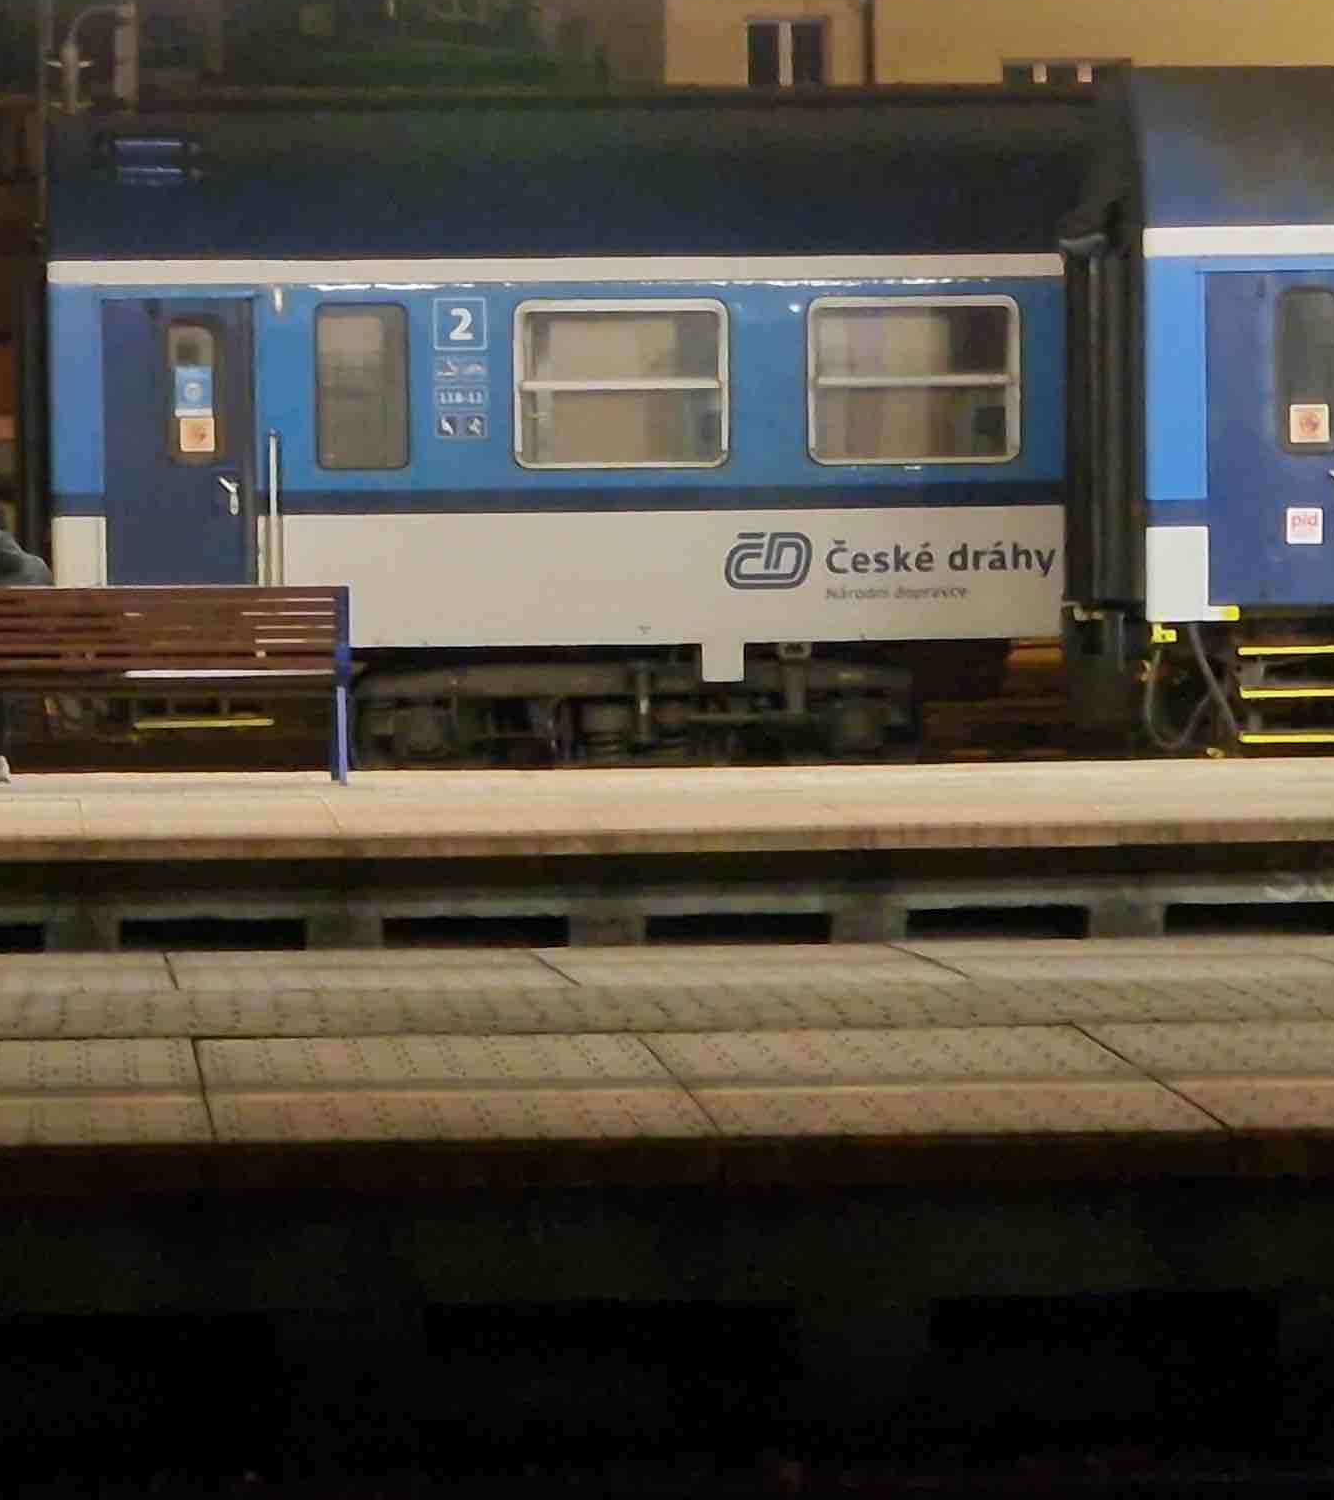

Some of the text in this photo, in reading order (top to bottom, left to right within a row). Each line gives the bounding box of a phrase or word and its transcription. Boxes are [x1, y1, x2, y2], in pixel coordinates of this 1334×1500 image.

[449, 307, 474, 341] 2
[825, 539, 1056, 578] České dráhy
